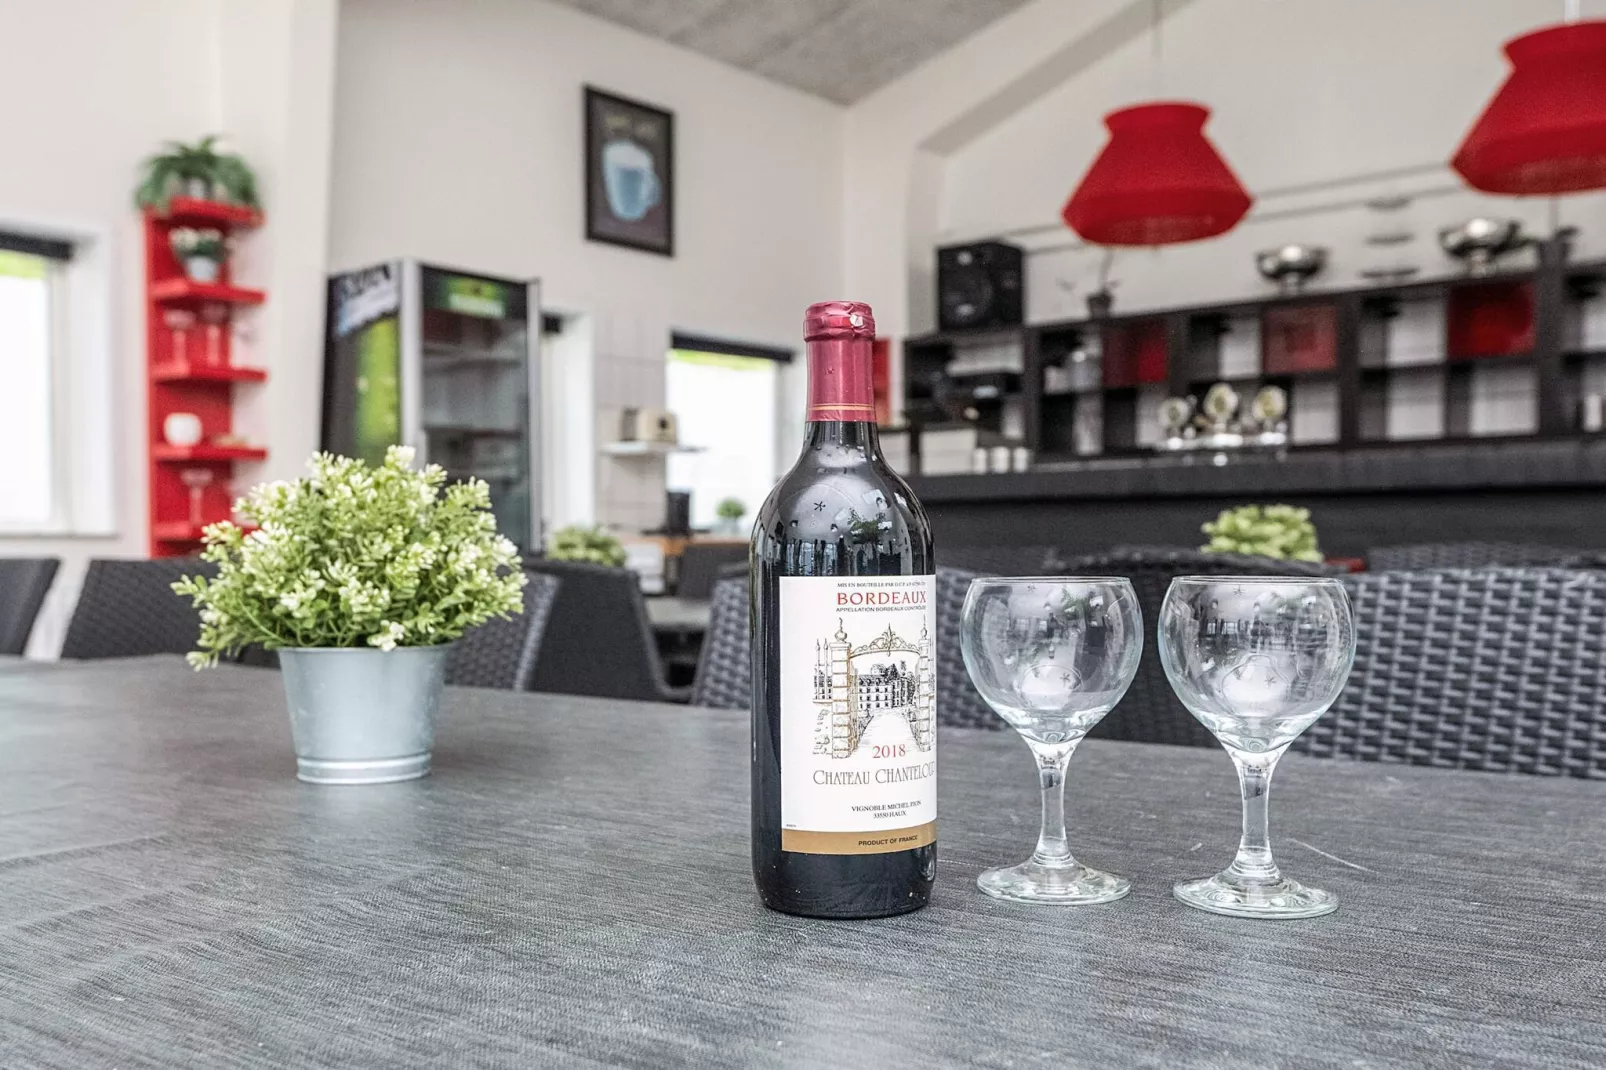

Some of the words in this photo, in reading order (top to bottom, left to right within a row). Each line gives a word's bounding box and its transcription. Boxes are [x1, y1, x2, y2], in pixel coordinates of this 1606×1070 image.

[837, 590, 927, 605] BORDEAUX
[873, 744, 906, 759] 2018
[813, 769, 870, 785] CHATEAU
[851, 804, 886, 812] VIGNOBLE
